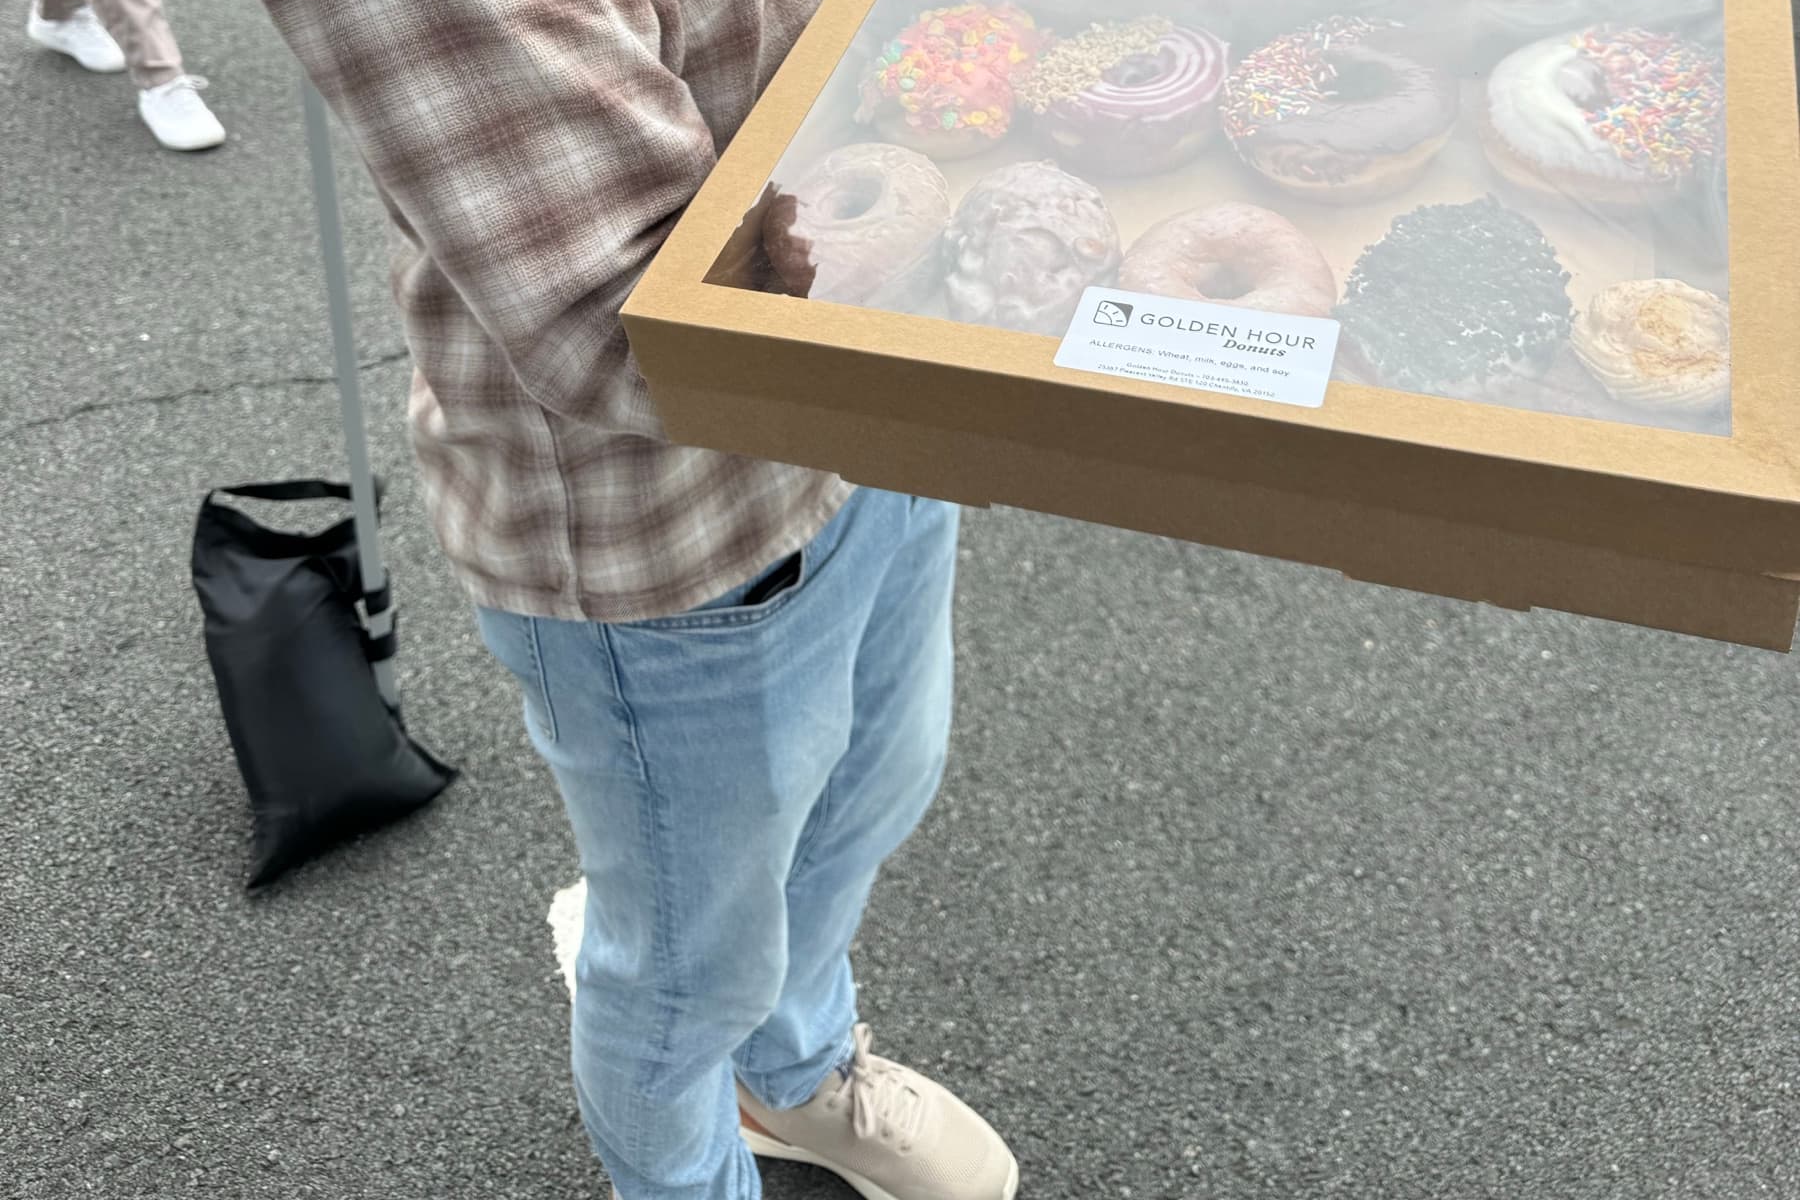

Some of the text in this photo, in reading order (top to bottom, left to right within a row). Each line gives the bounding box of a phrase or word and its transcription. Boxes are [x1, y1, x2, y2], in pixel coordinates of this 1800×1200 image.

[1140, 313, 1316, 350] GOLDEN HOUR
[1089, 339, 1290, 377] ALLERGENS: Wheat, milk, eggs, and soy
[1222, 338, 1287, 358] Donuts
[1126, 362, 1151, 370] Golden
[1170, 368, 1194, 378] Donuts
